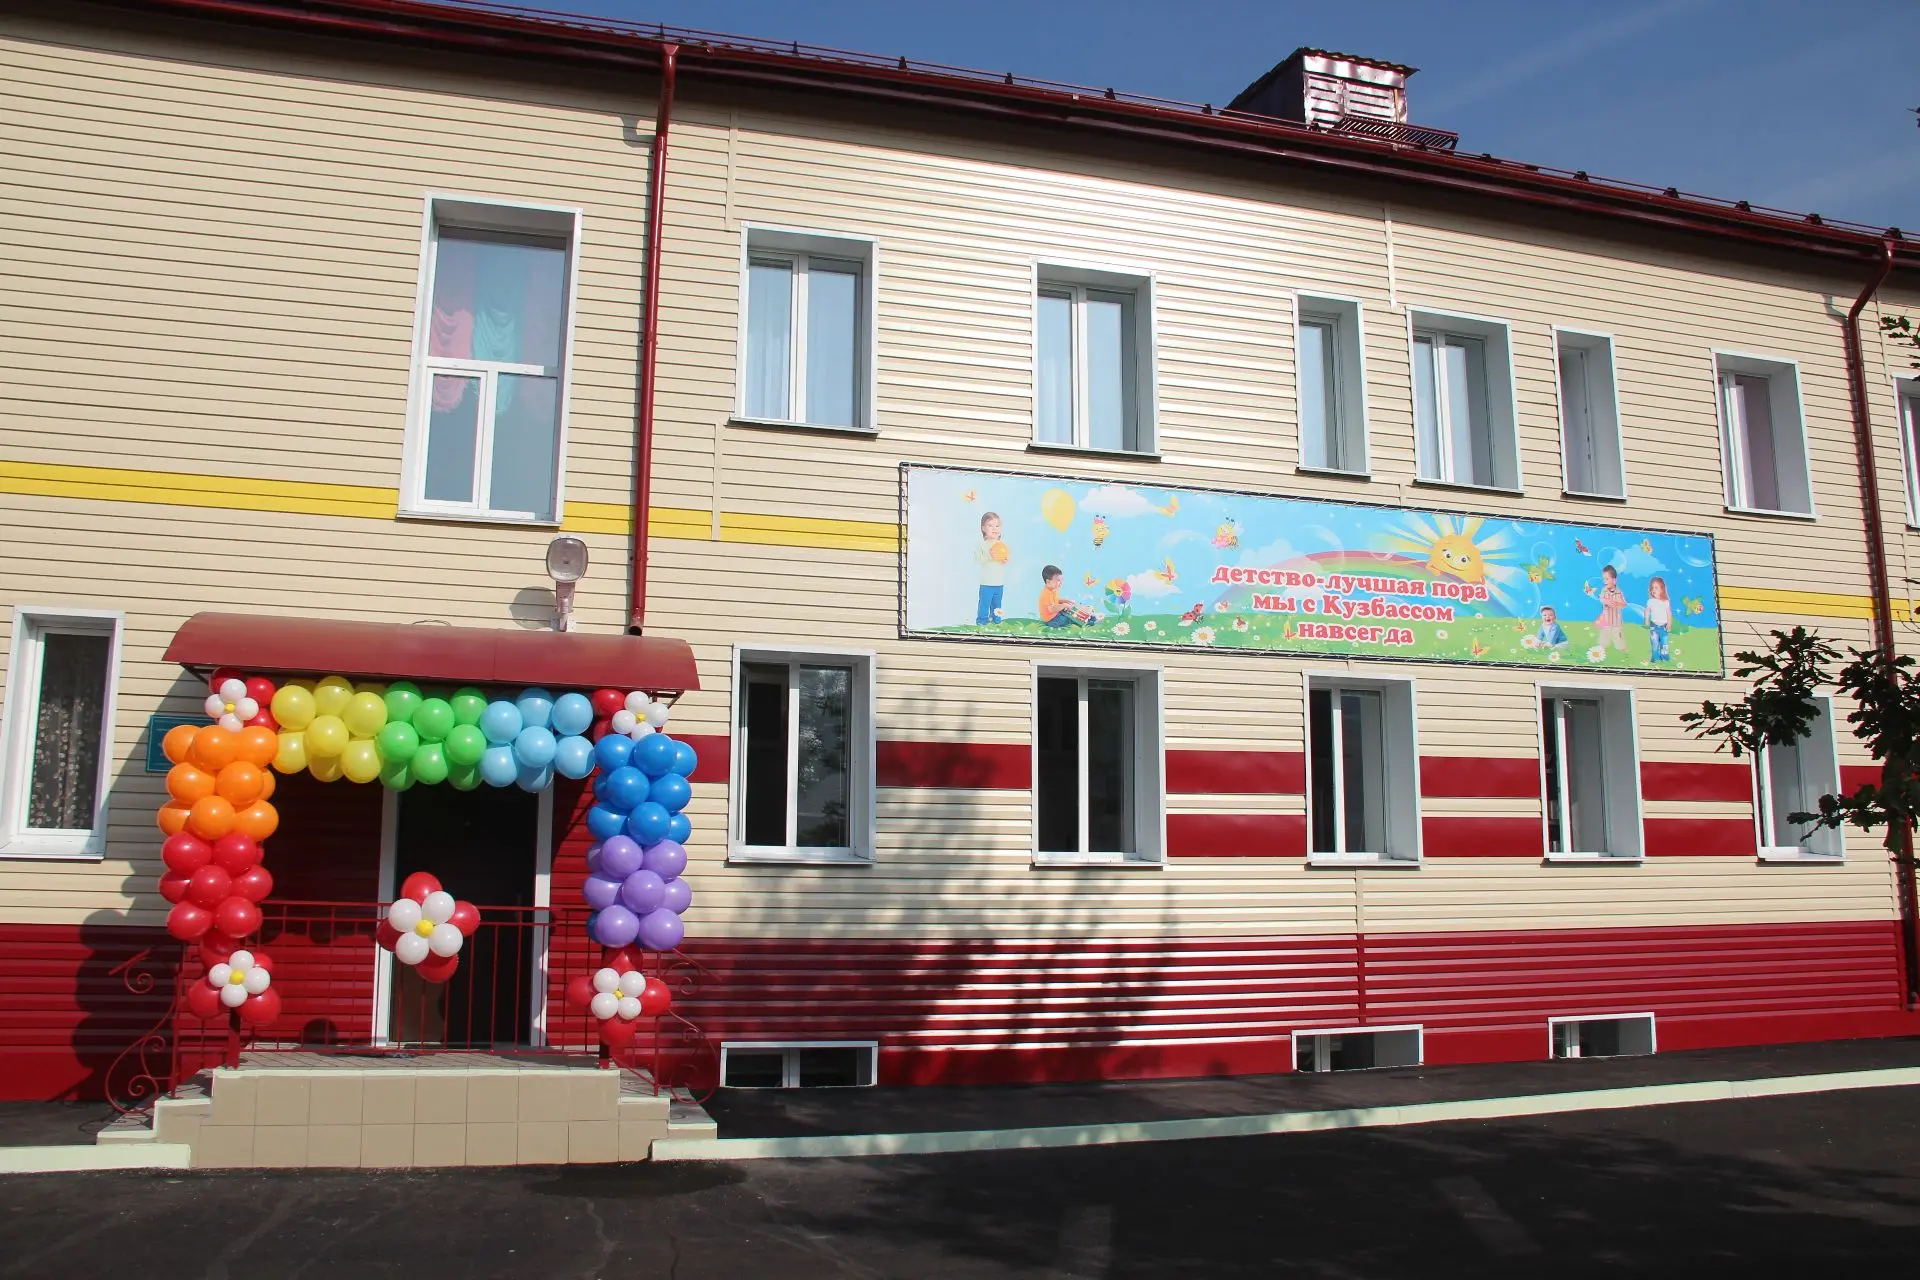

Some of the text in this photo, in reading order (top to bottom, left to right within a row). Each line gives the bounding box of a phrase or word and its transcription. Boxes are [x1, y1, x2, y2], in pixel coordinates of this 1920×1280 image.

[1211, 565, 1488, 602] детство-лучшая пора
[1252, 594, 1454, 622] мы с Кузбассом
[1298, 622, 1414, 645] навсегда
